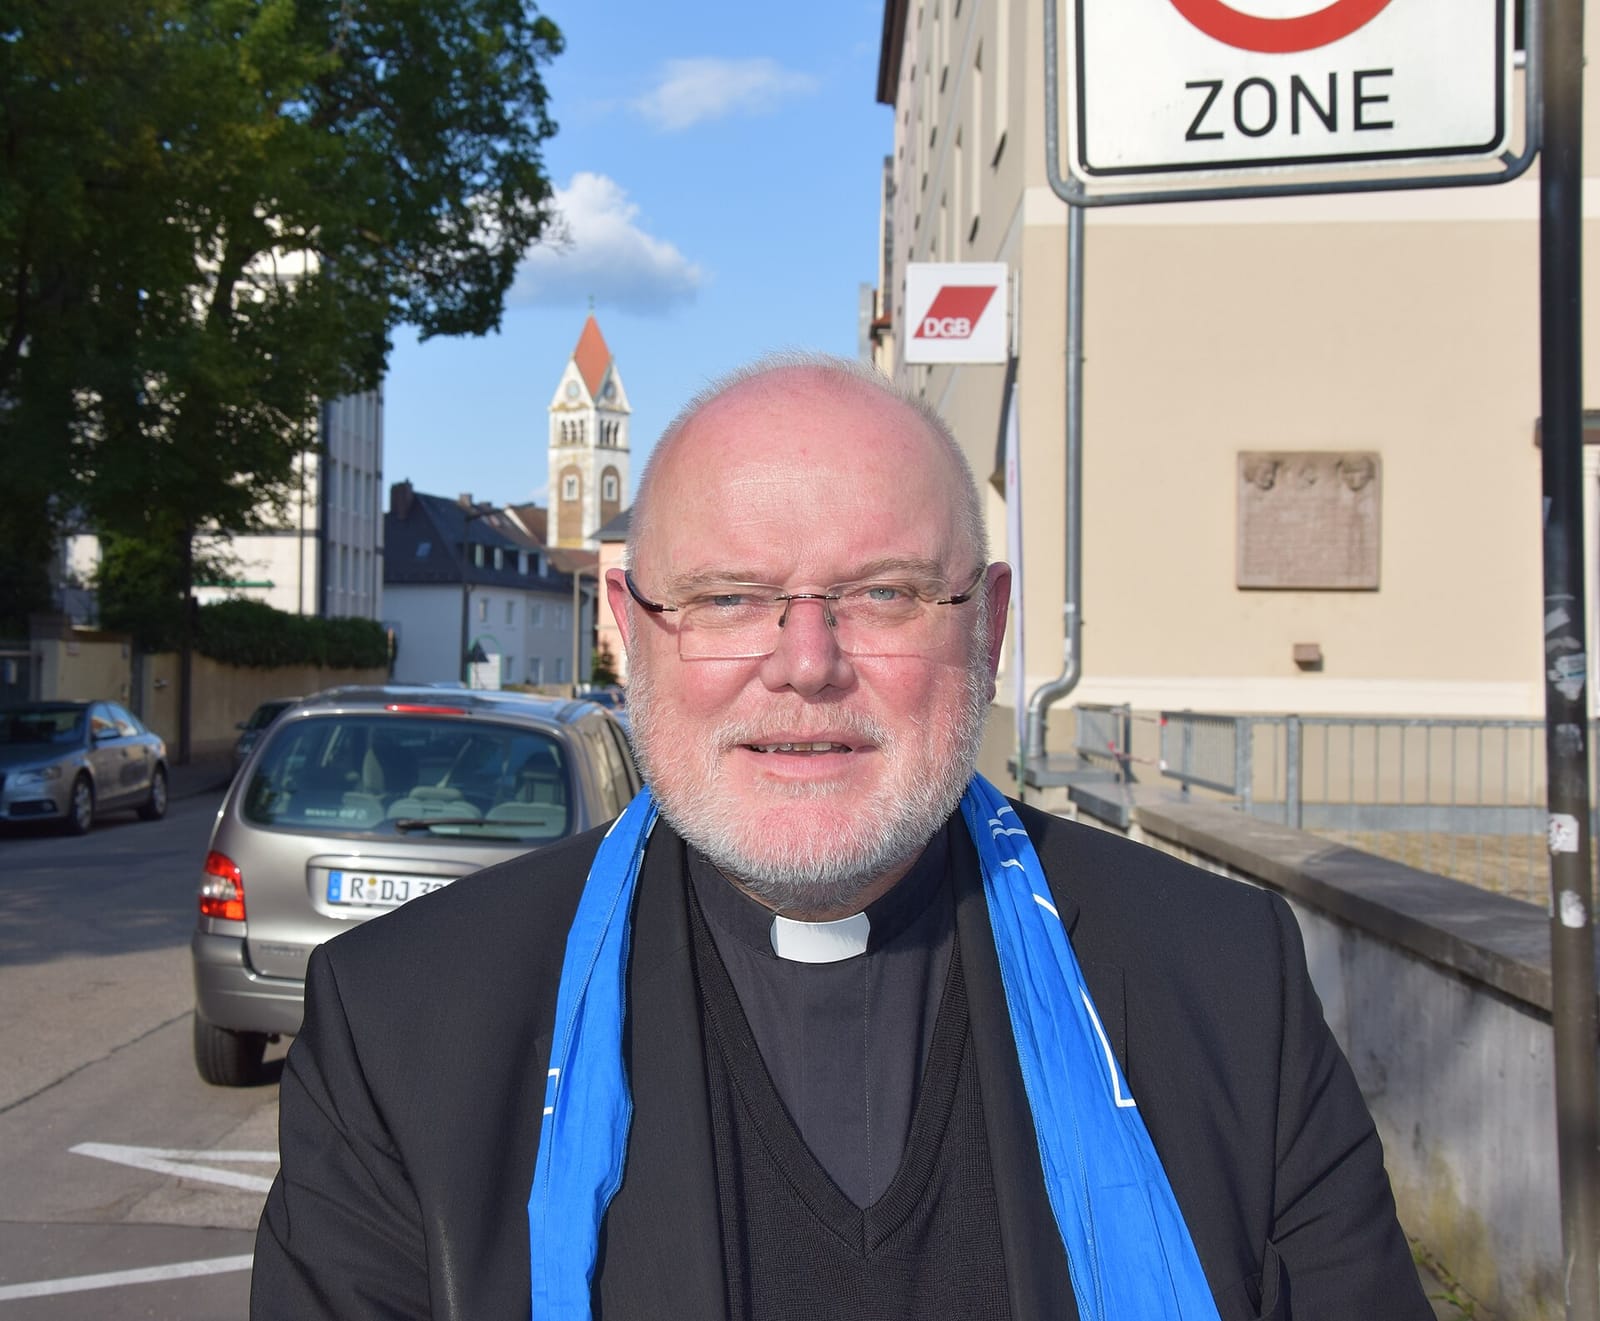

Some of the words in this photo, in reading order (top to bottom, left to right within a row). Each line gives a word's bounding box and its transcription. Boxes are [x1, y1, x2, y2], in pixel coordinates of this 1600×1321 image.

[1185, 68, 1394, 141] ZONE
[923, 317, 971, 337] DGB
[350, 878, 364, 899] R
[380, 880, 410, 901] DJ
